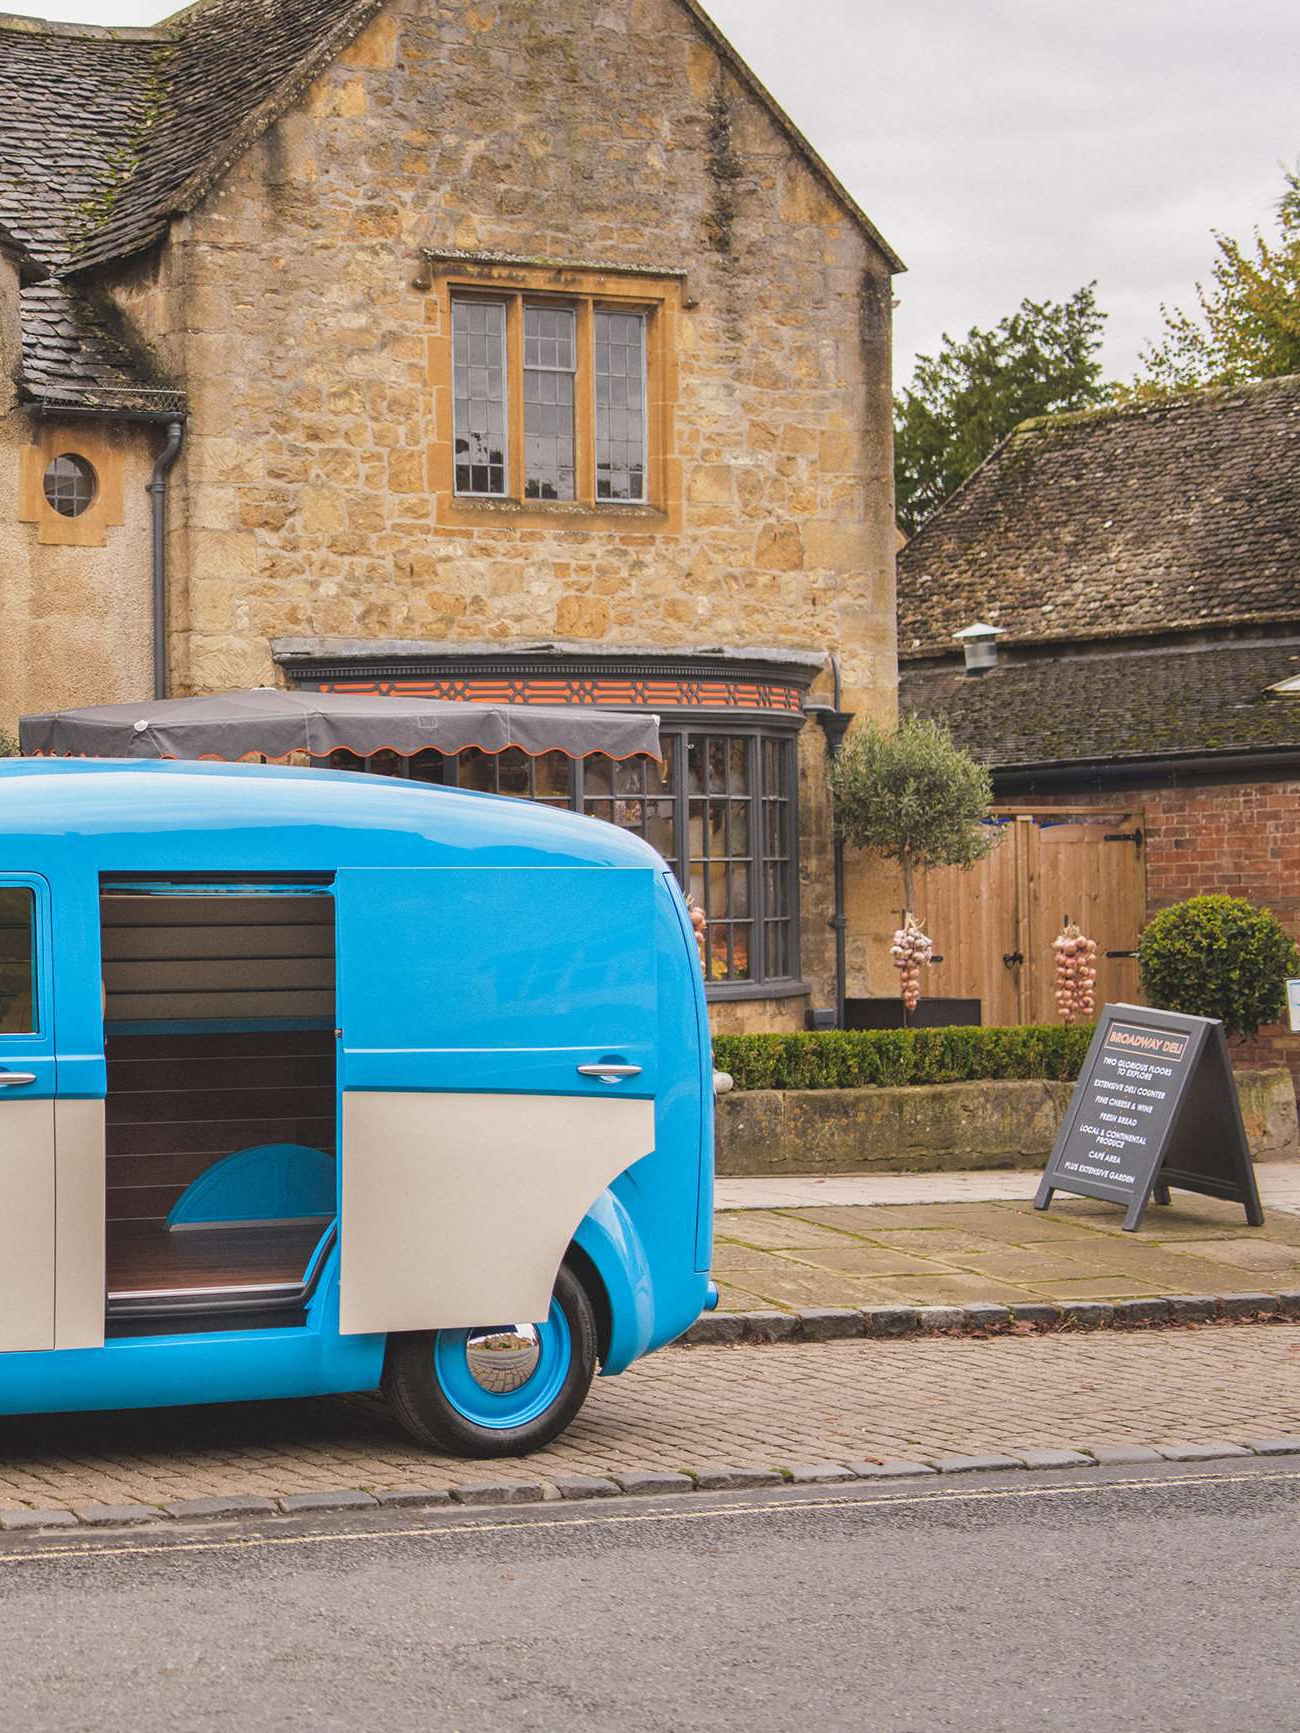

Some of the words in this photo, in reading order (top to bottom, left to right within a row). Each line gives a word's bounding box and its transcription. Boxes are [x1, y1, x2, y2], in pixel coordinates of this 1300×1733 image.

[1109, 1031, 1163, 1051] BROADWAY
[1163, 1041, 1185, 1054] DELI
[1103, 1057, 1117, 1066] TWO
[1117, 1059, 1148, 1072] GLORIOUS
[1148, 1065, 1173, 1077] FLOORS
[1117, 1067, 1126, 1076] TO
[1126, 1069, 1153, 1081] EXPLORE
[1093, 1079, 1124, 1092] EXTENSIVE
[1124, 1083, 1137, 1093] DELI
[1137, 1085, 1166, 1099] COUNTER
[1094, 1095, 1108, 1105] FINE
[1108, 1097, 1131, 1109] CHEESE
[1136, 1102, 1154, 1114] WINE
[1099, 1112, 1117, 1122] FRESH
[1117, 1115, 1138, 1127] BREAD
[1079, 1123, 1100, 1135] LOCAL
[1105, 1130, 1147, 1145] CONTINENTAL
[1095, 1136, 1125, 1149] PRODUCE
[1105, 1154, 1121, 1164] AREA
[1064, 1161, 1079, 1171] PLUS
[1078, 1164, 1109, 1178] EXTENSIVE
[1109, 1171, 1136, 1184] GARDEN
